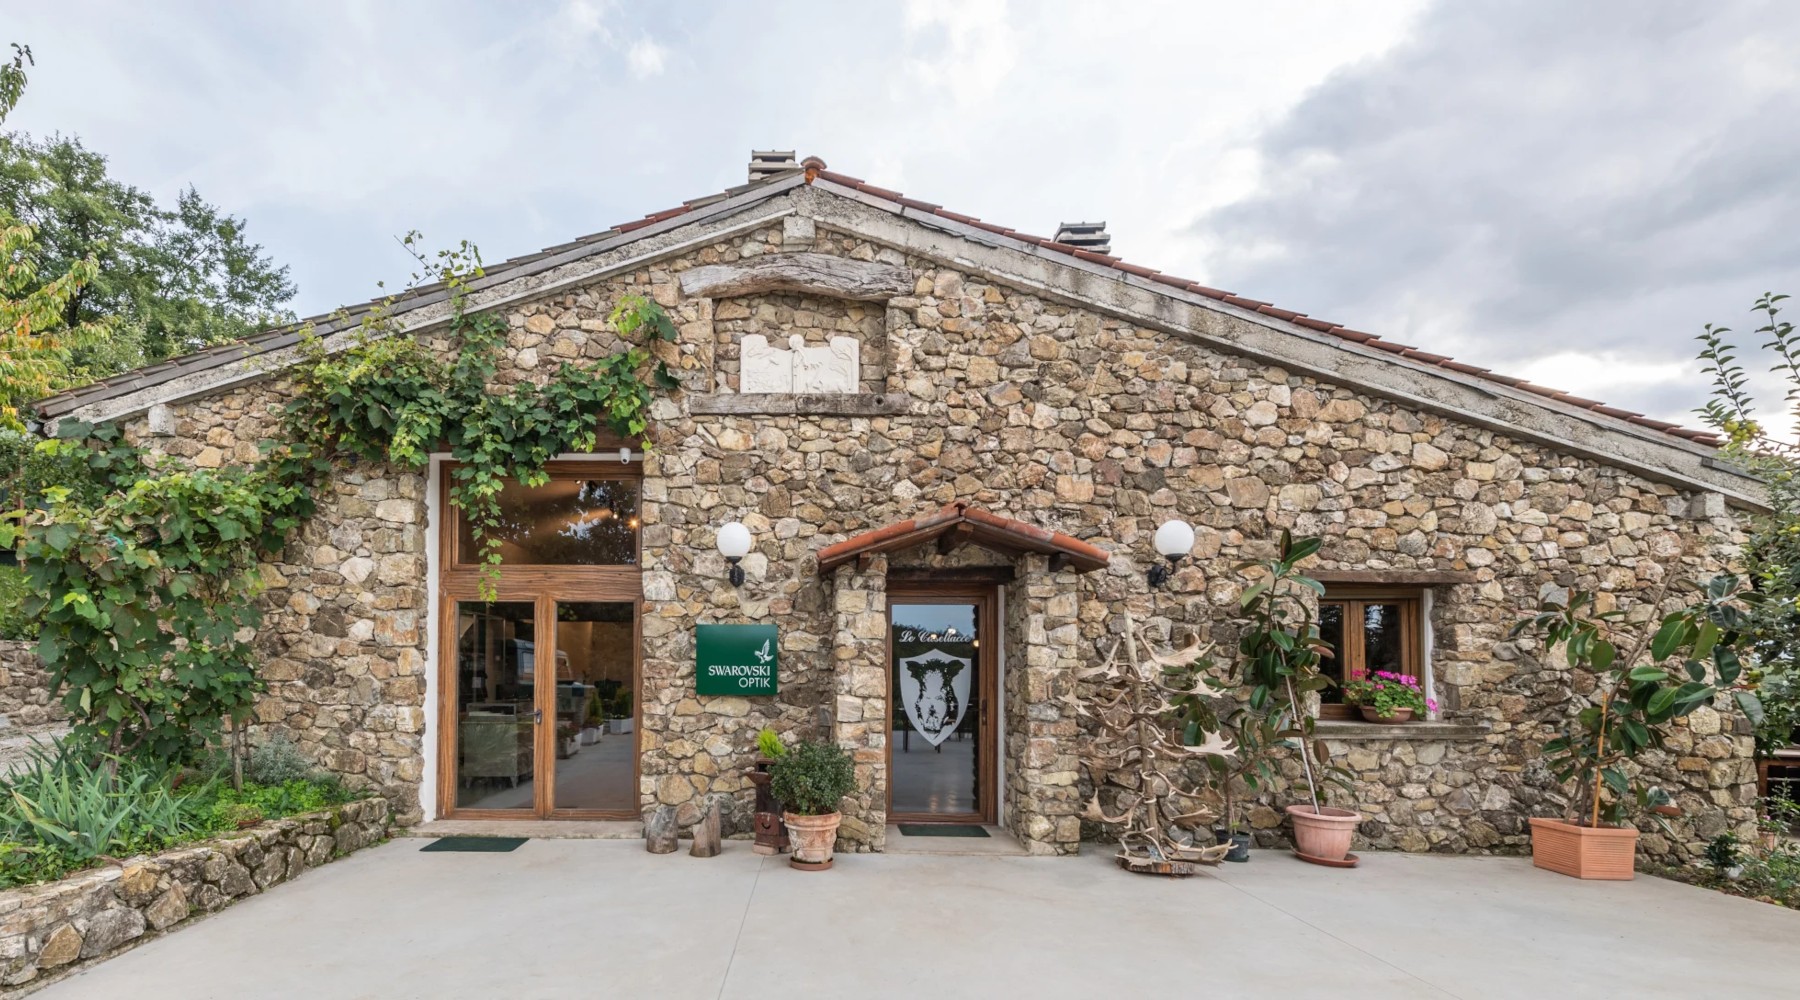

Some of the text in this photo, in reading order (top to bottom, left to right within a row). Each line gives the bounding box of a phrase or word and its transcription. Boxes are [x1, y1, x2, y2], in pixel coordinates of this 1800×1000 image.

[899, 630, 916, 643] Le
[708, 665, 771, 677] SWAROVSKI
[738, 677, 771, 688] OPTIK
